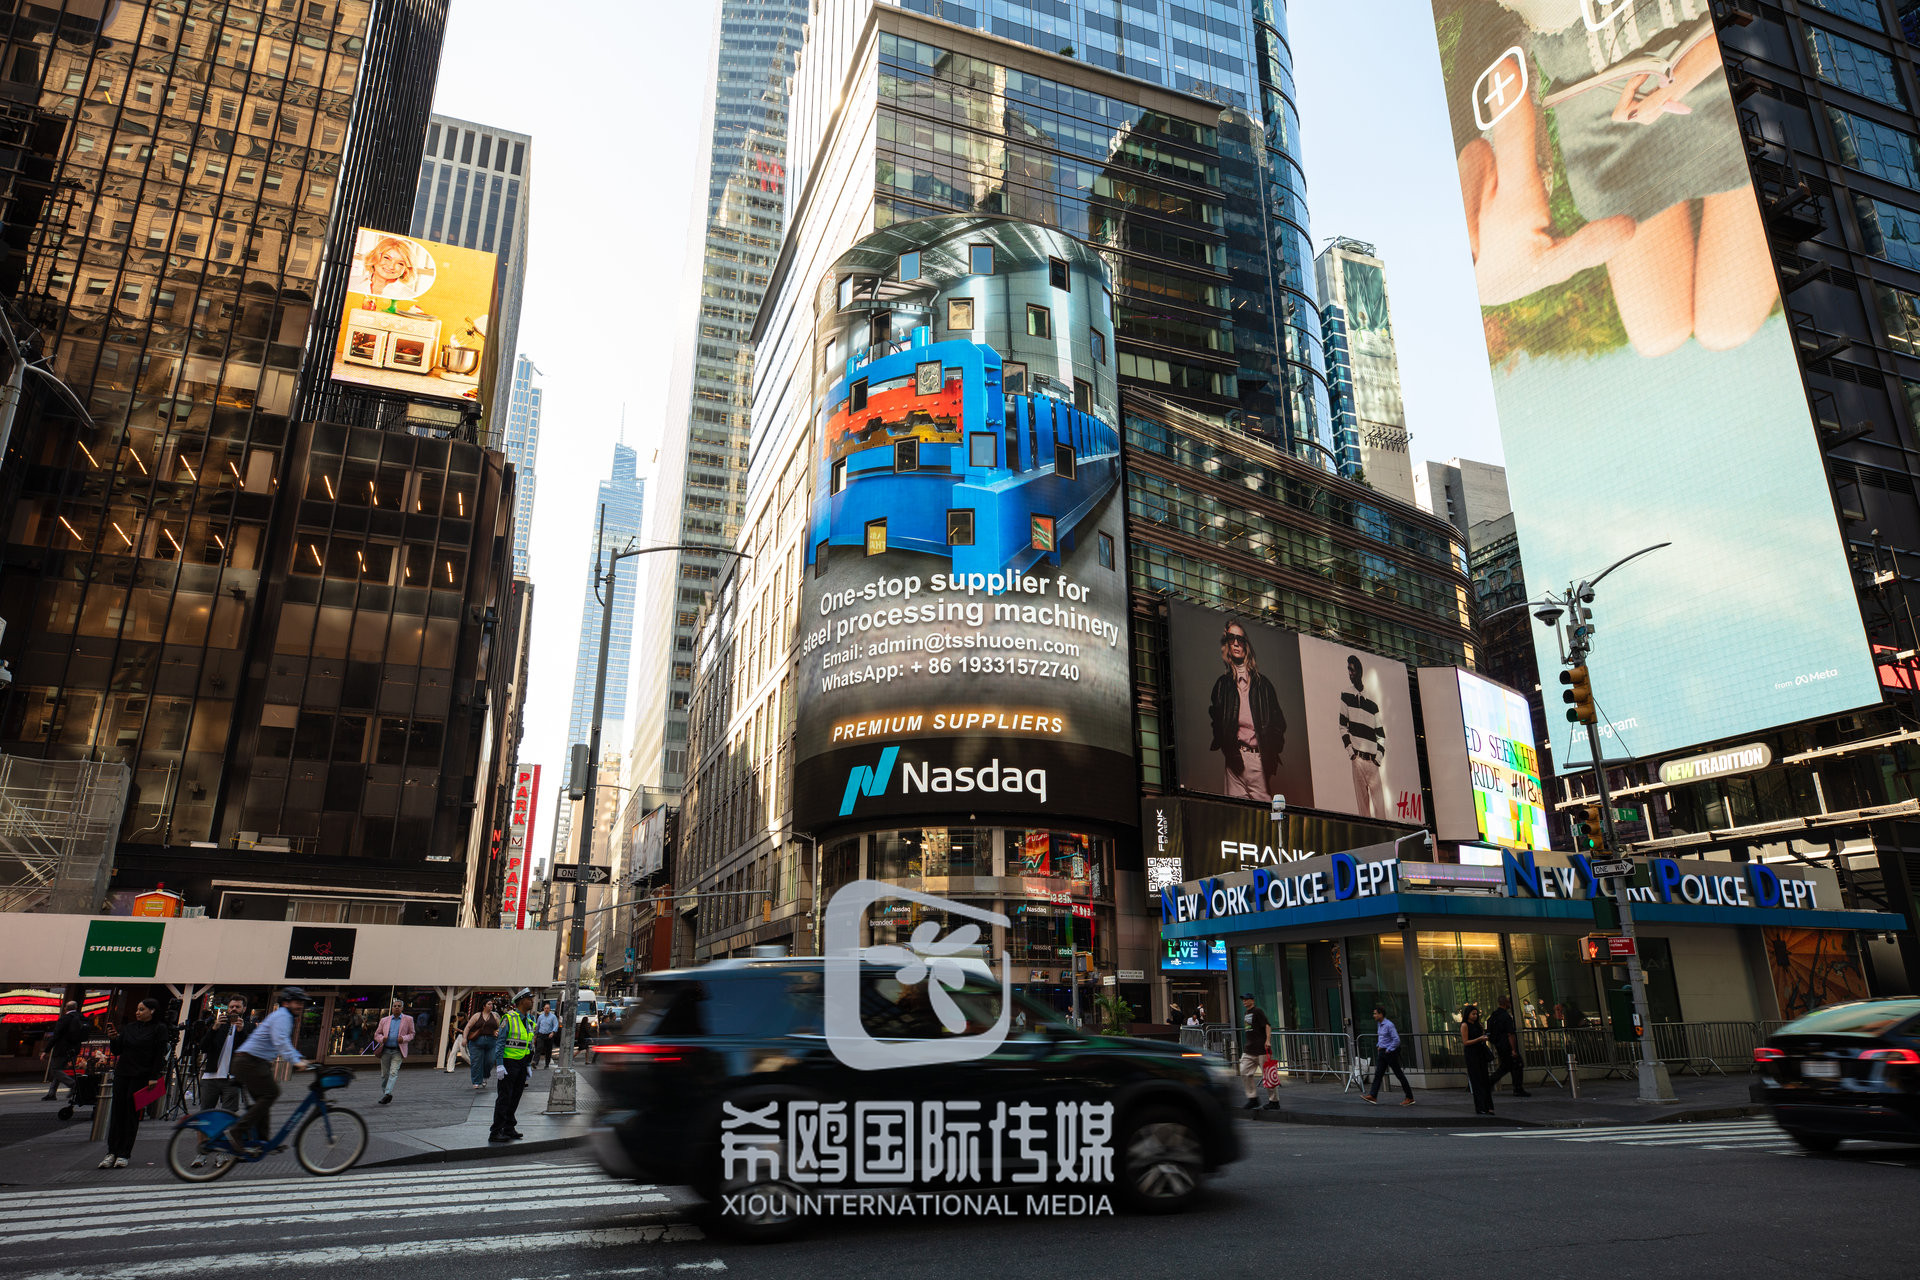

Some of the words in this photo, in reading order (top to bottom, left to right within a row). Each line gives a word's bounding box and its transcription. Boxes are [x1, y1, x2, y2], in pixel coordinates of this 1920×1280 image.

[820, 576, 922, 615] One-stop
[931, 569, 1049, 597] supplier
[1057, 575, 1090, 603] for
[803, 620, 831, 656] steel
[837, 599, 984, 638] processing
[995, 602, 1119, 647] machinery
[822, 644, 863, 670] Email:
[868, 633, 1081, 658] admin@tsshuoen.com
[821, 662, 905, 693] WhatsApp:
[929, 657, 952, 674] 86
[959, 655, 1080, 682] 19331572740
[1775, 681, 1793, 690] from
[1809, 669, 1838, 682] Meta
[833, 715, 923, 743] PREMIUM
[933, 713, 1064, 733] SUPPLIERS
[1571, 717, 1638, 743] Insagram
[514, 772, 530, 825] PARK
[903, 759, 1047, 804] Nasdaq
[1397, 791, 1422, 822] H&M
[1156, 809, 1165, 852] FRANK
[504, 858, 521, 912] PARK
[562, 870, 577, 878] ONE
[1502, 849, 1575, 899] NEW
[1658, 859, 1749, 907] POLICE
[1748, 864, 1817, 909] DEPT
[1616, 863, 1628, 871] WAY
[1161, 885, 1199, 925] NEW
[1199, 878, 1251, 919] YORK
[1253, 869, 1325, 911] POLICE
[1332, 853, 1398, 899] DEPT
